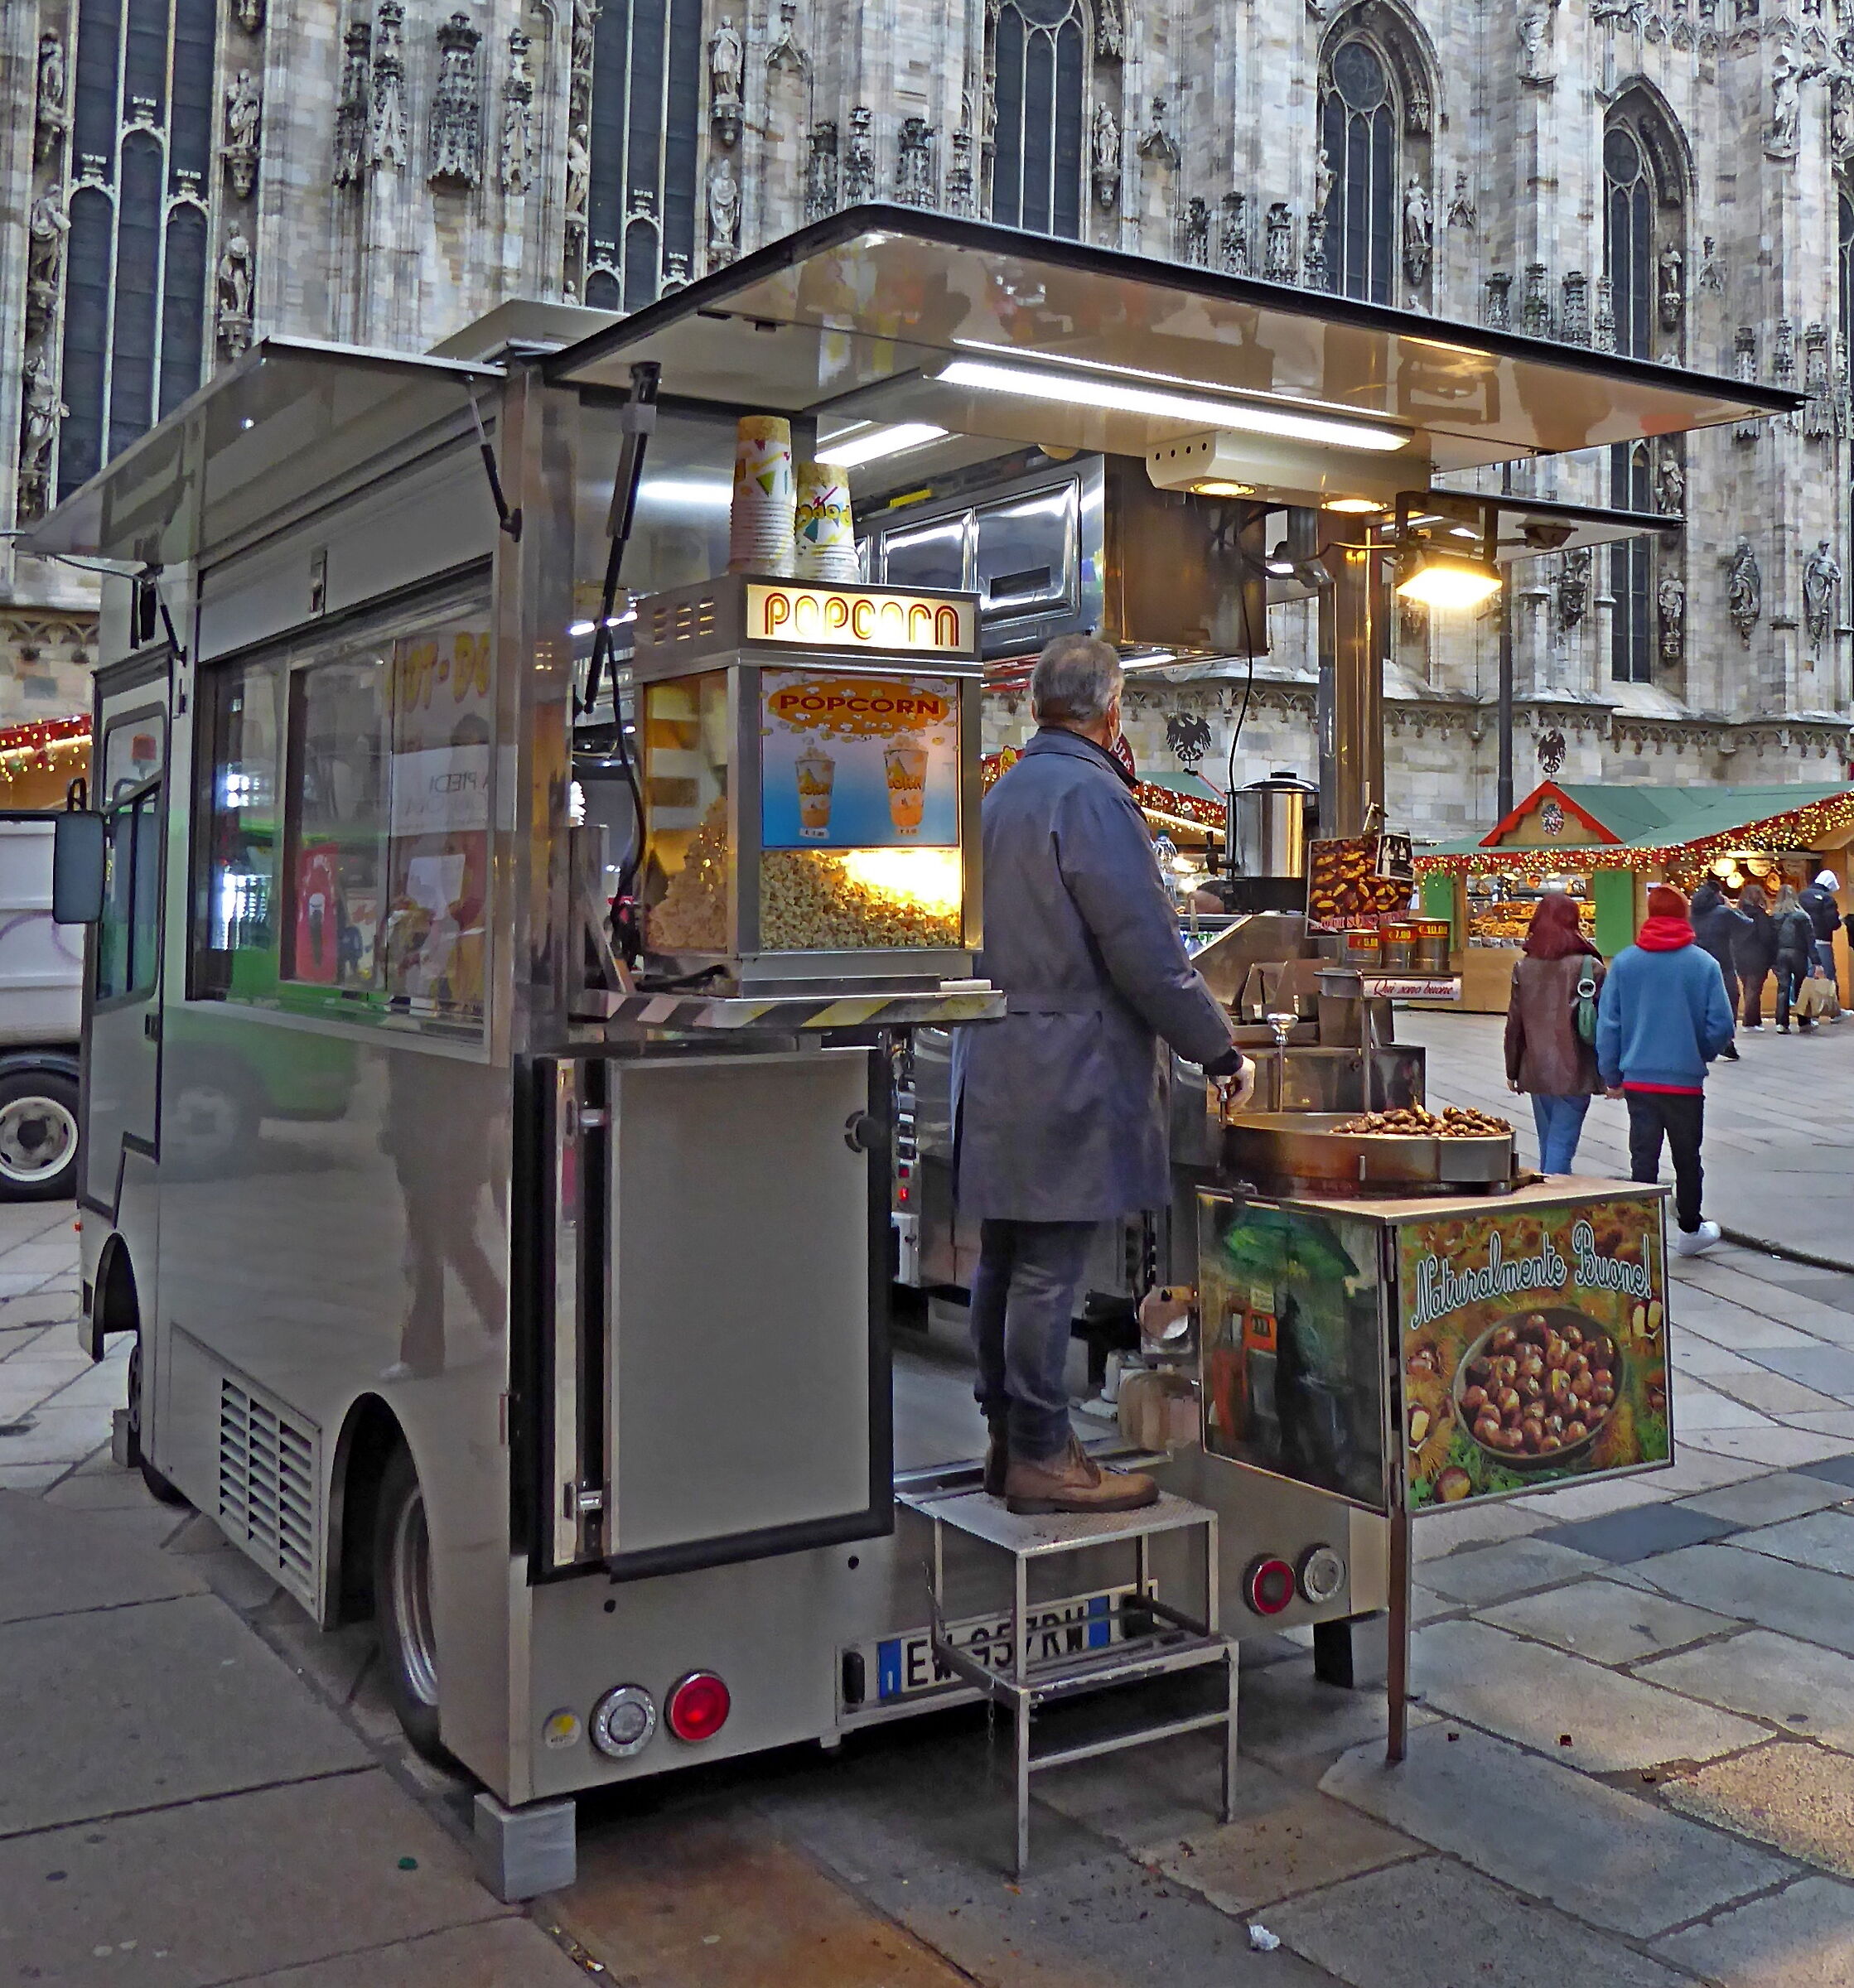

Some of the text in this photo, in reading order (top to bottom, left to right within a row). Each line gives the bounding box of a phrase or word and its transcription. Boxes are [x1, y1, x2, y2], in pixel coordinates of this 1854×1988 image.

[780, 694, 939, 715] POPCORN
[1374, 978, 1395, 997] Qui
[1411, 1220, 1652, 1330] Naturalmente Buone!
